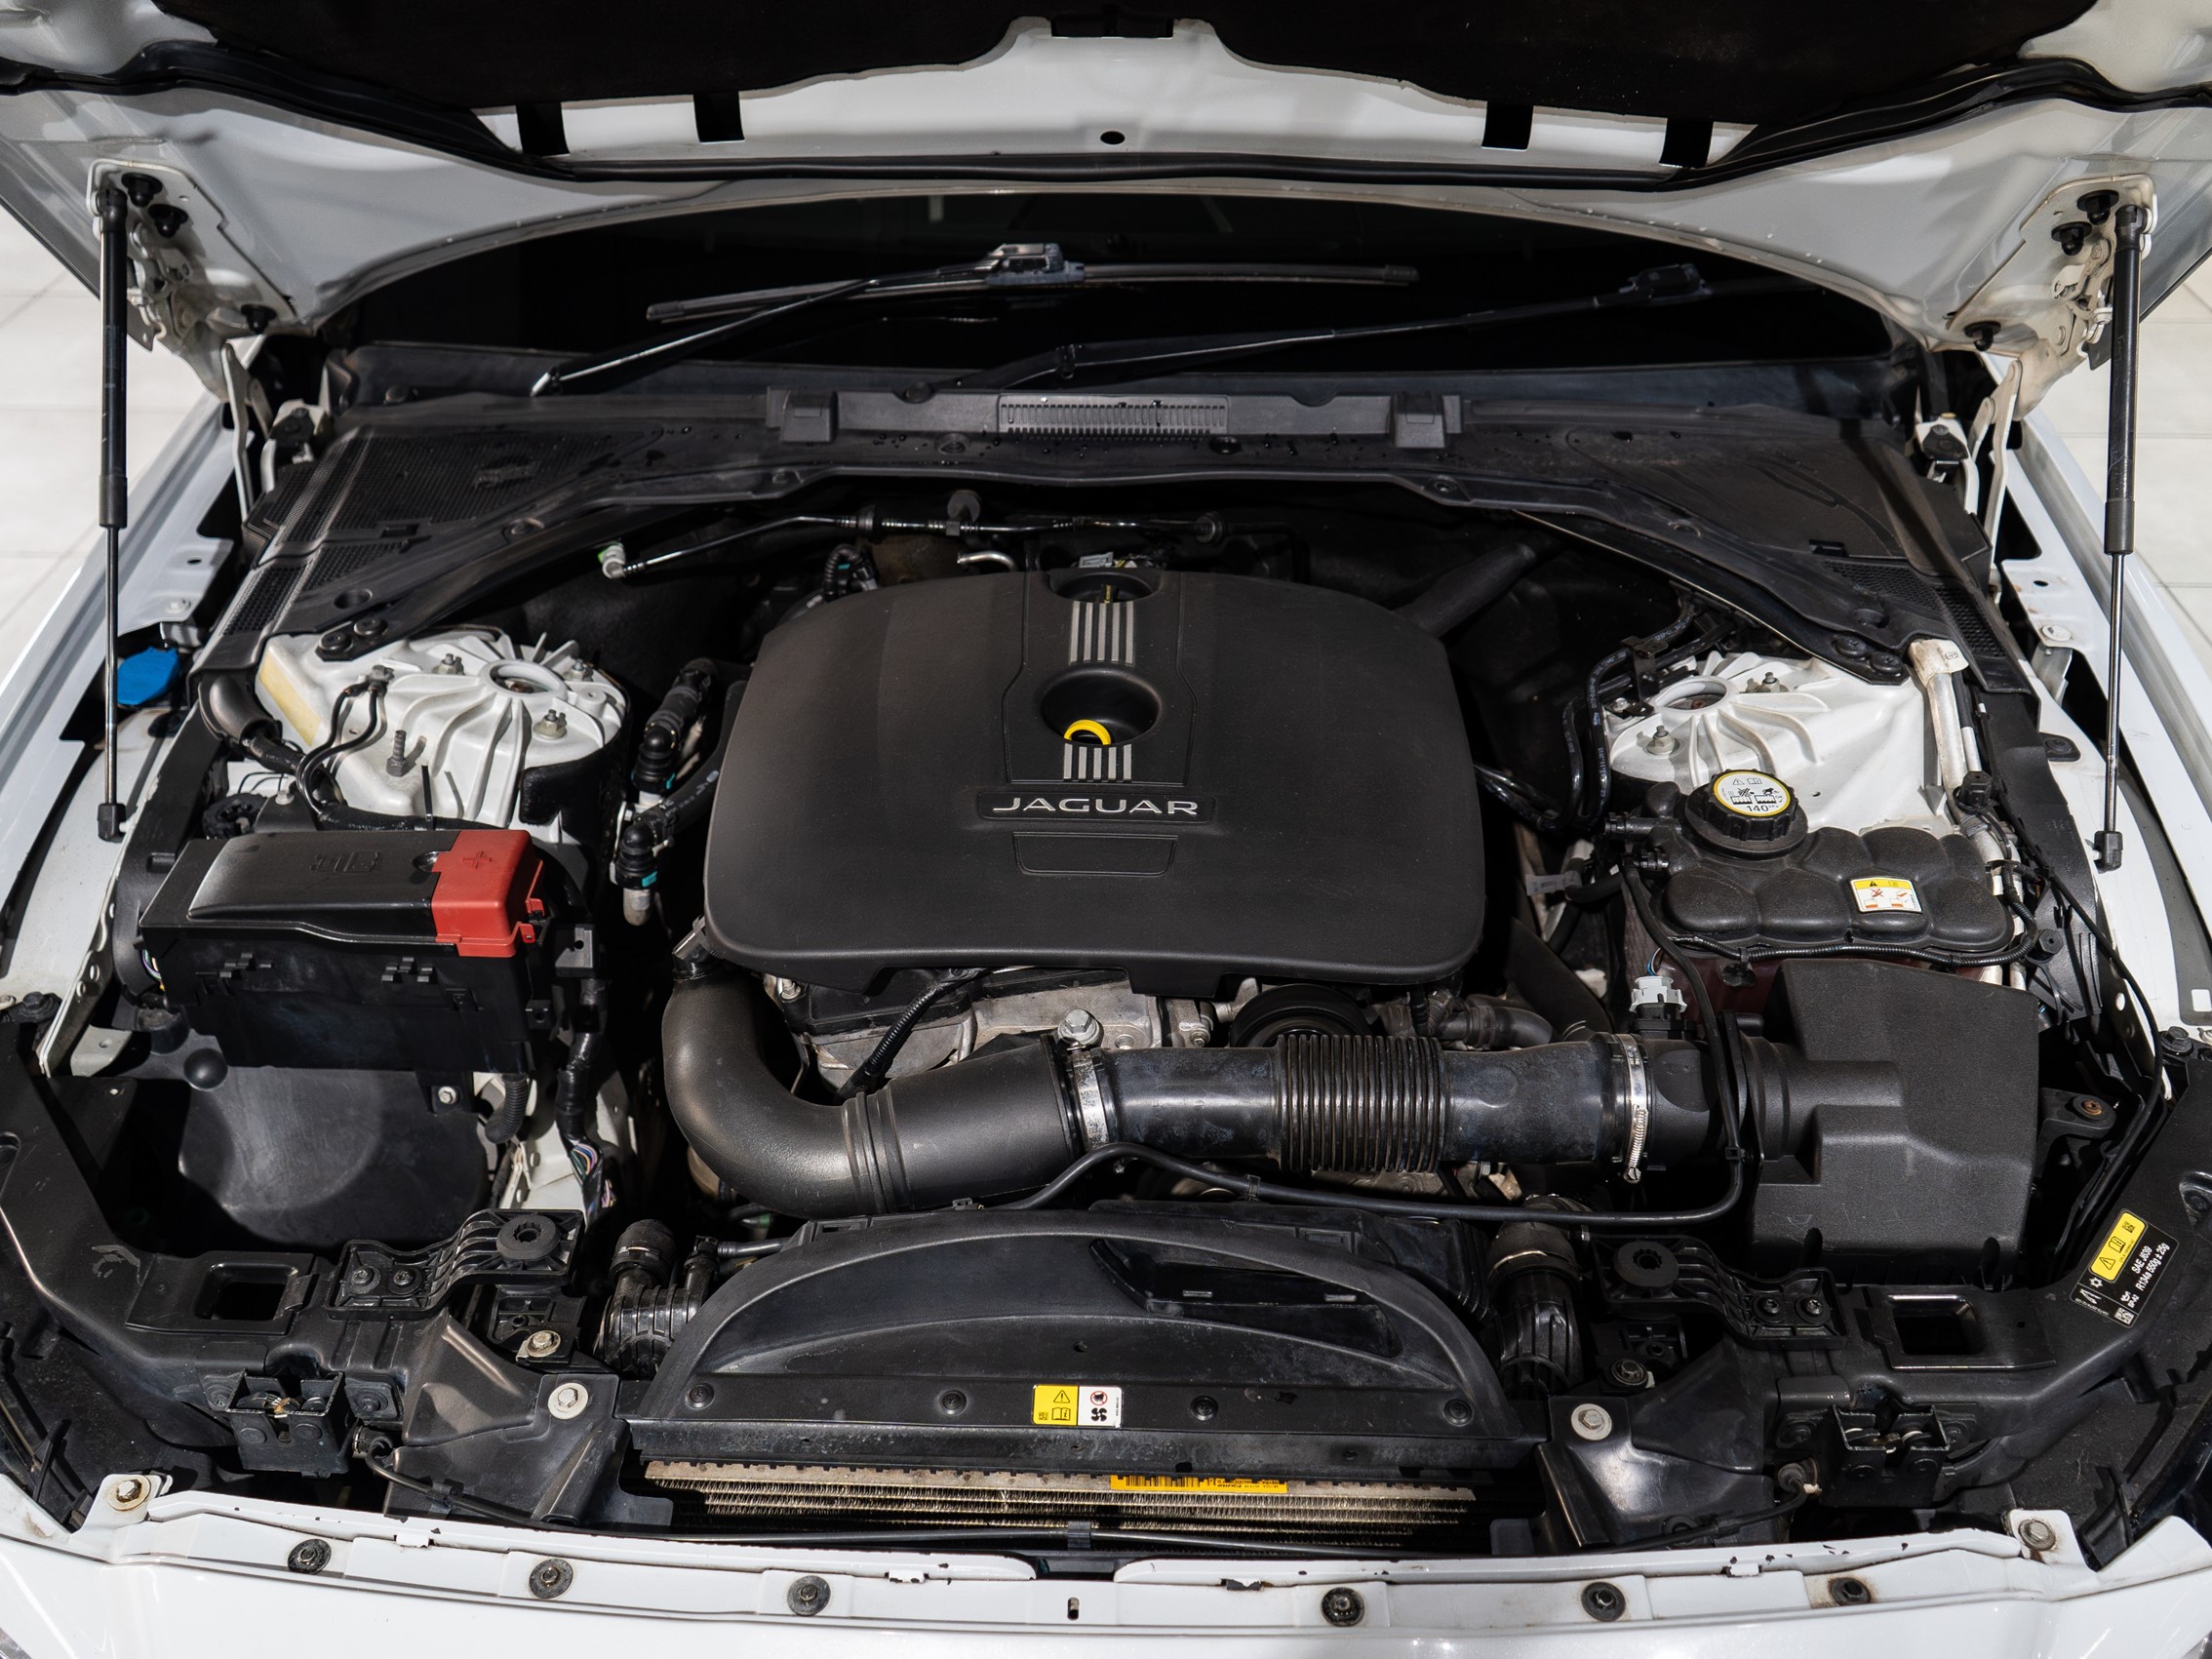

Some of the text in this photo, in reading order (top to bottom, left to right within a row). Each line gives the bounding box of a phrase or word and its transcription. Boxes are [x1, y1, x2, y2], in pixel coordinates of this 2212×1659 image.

[993, 798, 1198, 815] JAGUAR
[2131, 1245, 2153, 1274] SAE J639
[2134, 1271, 2153, 1291] R134a
[2155, 1243, 2171, 1253] 25g
